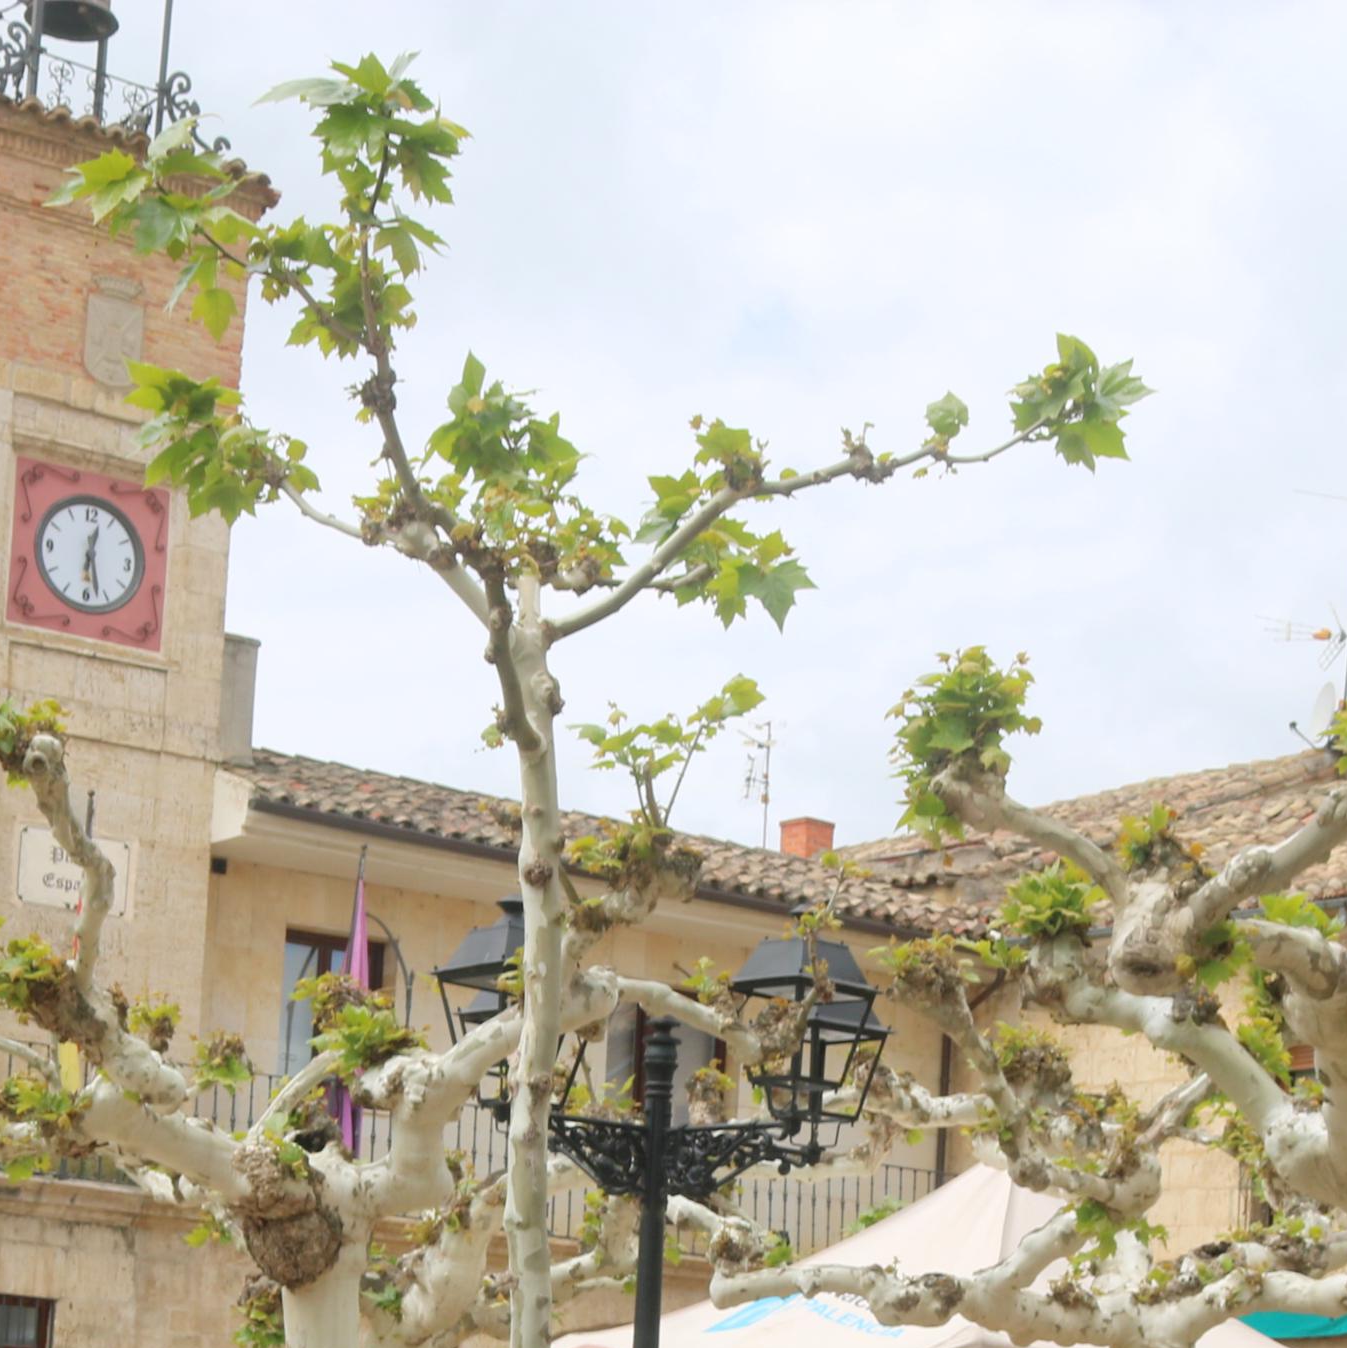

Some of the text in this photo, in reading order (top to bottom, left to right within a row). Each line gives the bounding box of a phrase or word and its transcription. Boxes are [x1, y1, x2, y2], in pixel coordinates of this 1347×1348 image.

[85, 507, 98, 523] 12
[46, 538, 54, 553] 9
[123, 557, 131, 572] 3
[82, 587, 90, 602] 6
